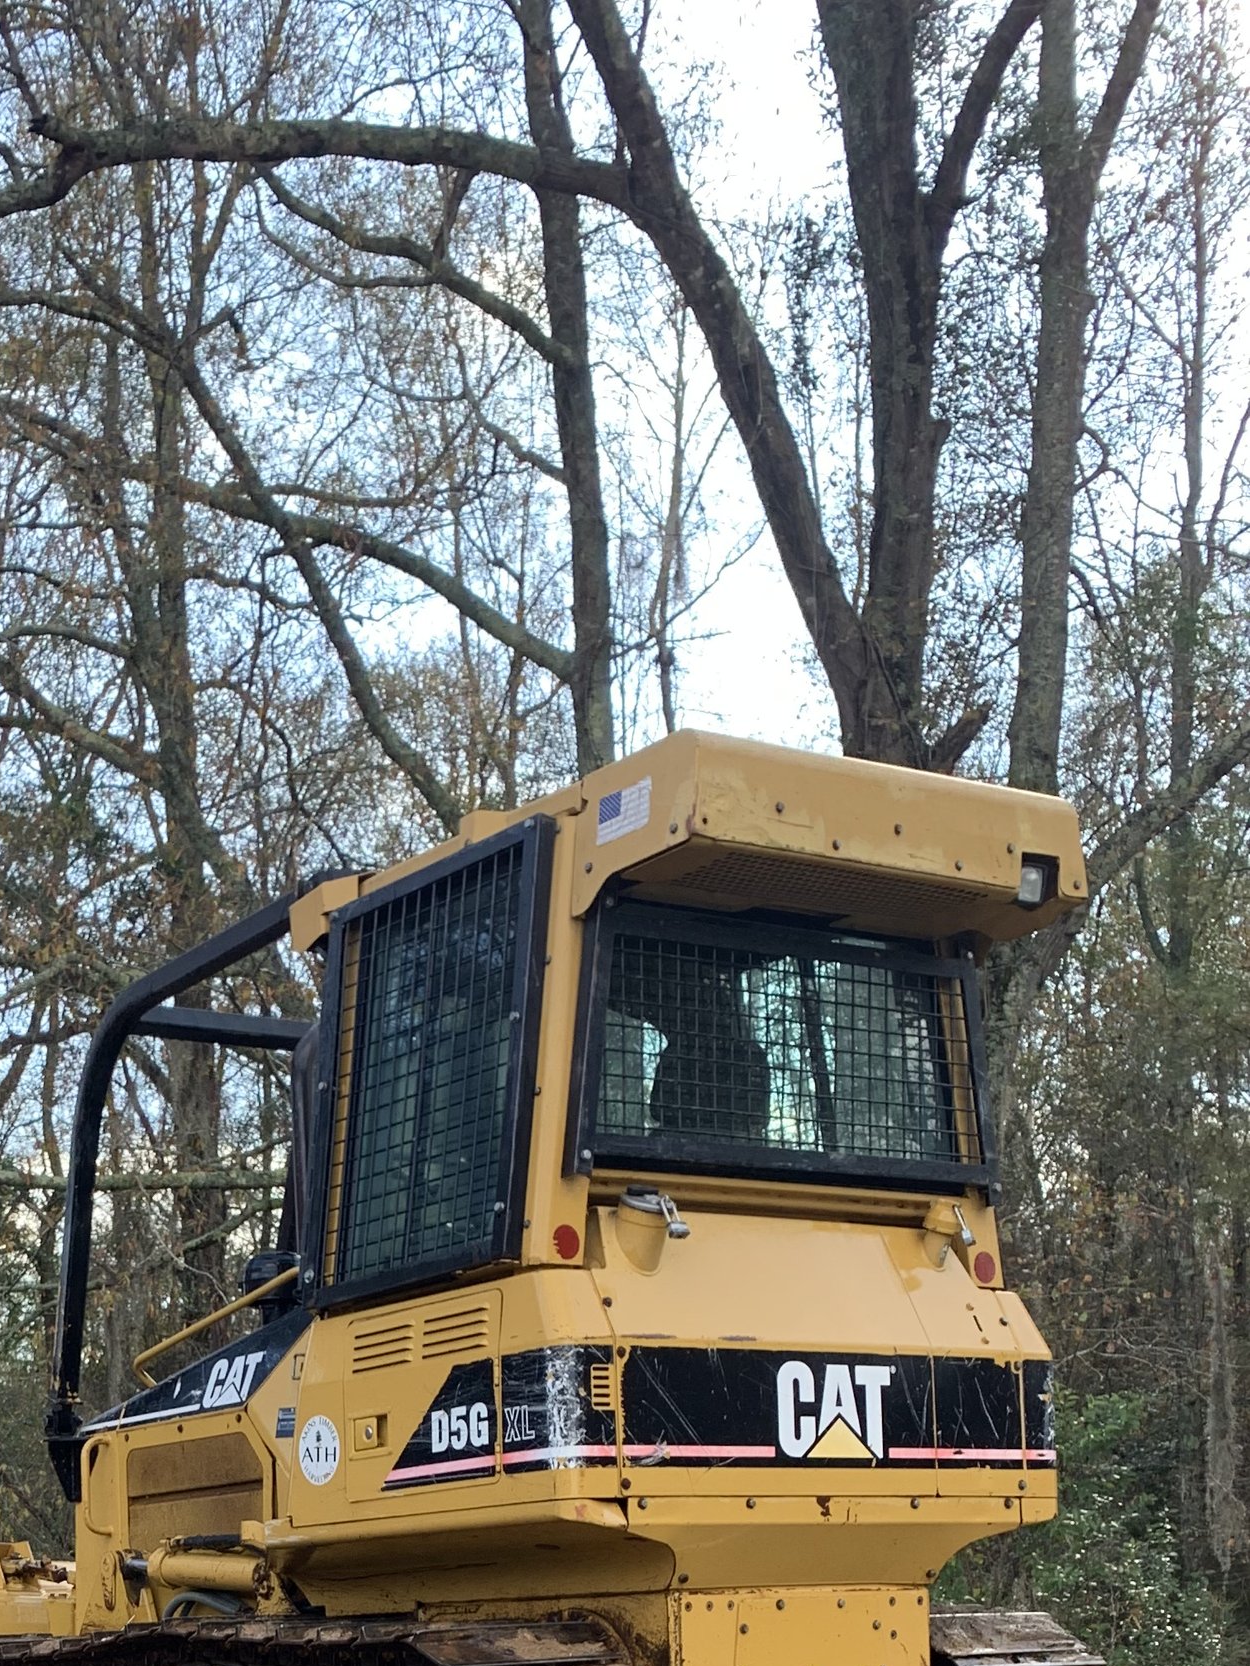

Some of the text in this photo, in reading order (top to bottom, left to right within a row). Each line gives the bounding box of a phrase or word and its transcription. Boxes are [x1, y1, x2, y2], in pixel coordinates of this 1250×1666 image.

[203, 1351, 265, 1408] CAT
[431, 1402, 535, 1453] D5G XL
[777, 1360, 891, 1459] CAT
[301, 1446, 337, 1463] ATH
